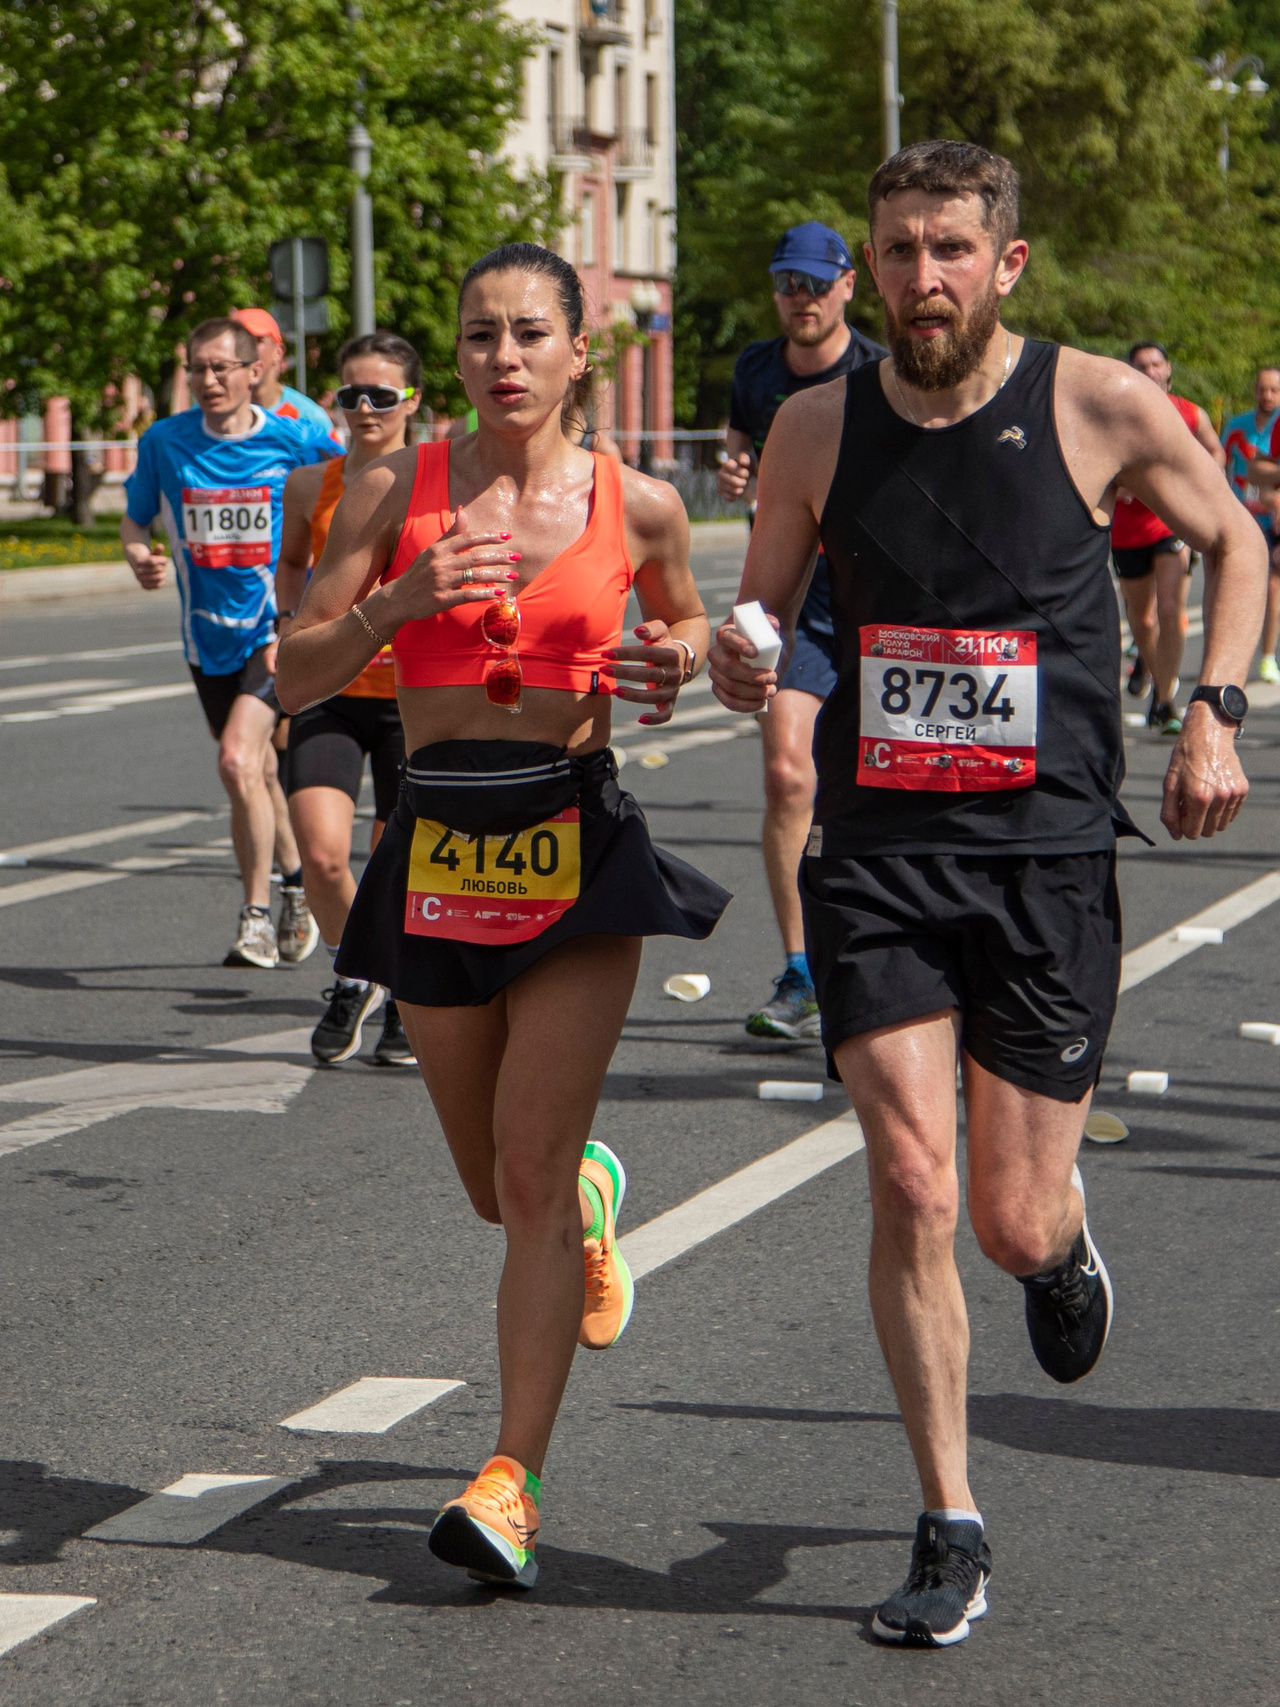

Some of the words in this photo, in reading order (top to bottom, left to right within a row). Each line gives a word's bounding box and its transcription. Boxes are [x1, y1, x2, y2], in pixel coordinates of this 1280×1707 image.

[188, 507, 268, 532] 11806
[878, 629, 940, 643] МОСКОВСКИЙ
[881, 666, 1016, 723] 8734
[915, 723, 977, 741] СЕРГЕЙ
[429, 829, 560, 877] 4140
[460, 878, 528, 895] ЛЮБОВЬ
